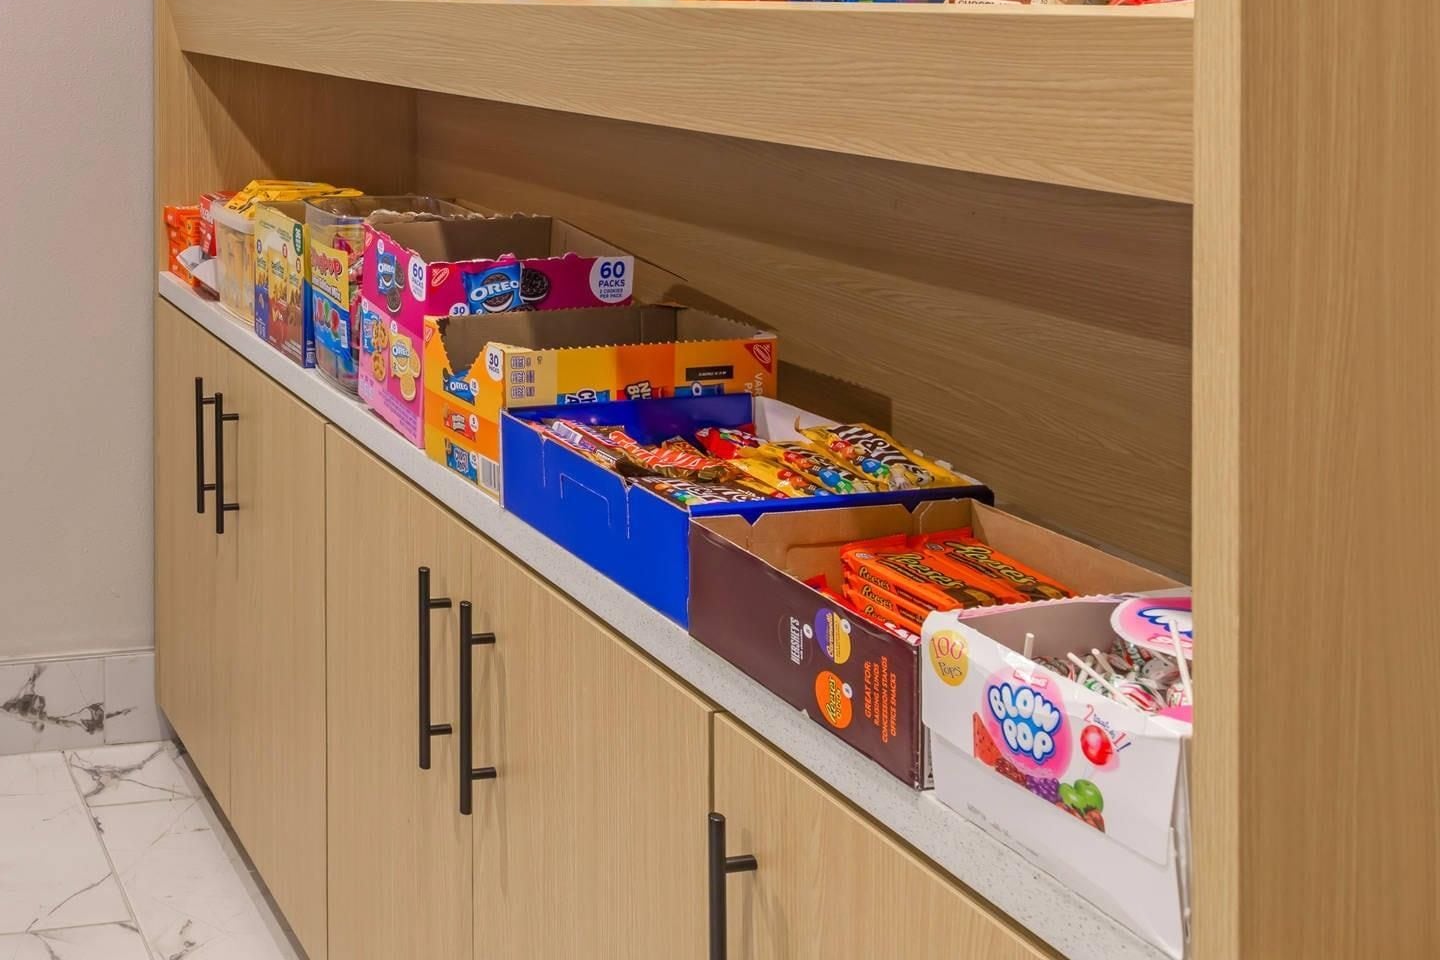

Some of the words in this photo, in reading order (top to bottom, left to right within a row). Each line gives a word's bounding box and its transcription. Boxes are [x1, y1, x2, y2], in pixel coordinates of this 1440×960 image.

[411, 262, 425, 281] 60
[599, 260, 626, 279] 60
[470, 279, 520, 302] OREO
[598, 279, 626, 288] PACKS
[453, 305, 466, 315] 30
[488, 353, 500, 368] 30
[931, 637, 965, 660] 100
[863, 660, 872, 685] FOR:
[881, 655, 889, 688] STANDS
[938, 661, 963, 680] Pops
[889, 672, 897, 706] SNACKS
[863, 685, 872, 719] GREAT
[988, 682, 1063, 735] BLOW
[881, 688, 889, 744] CONCESSION
[889, 707, 897, 737] OFFICE
[1001, 717, 1057, 766] POP
